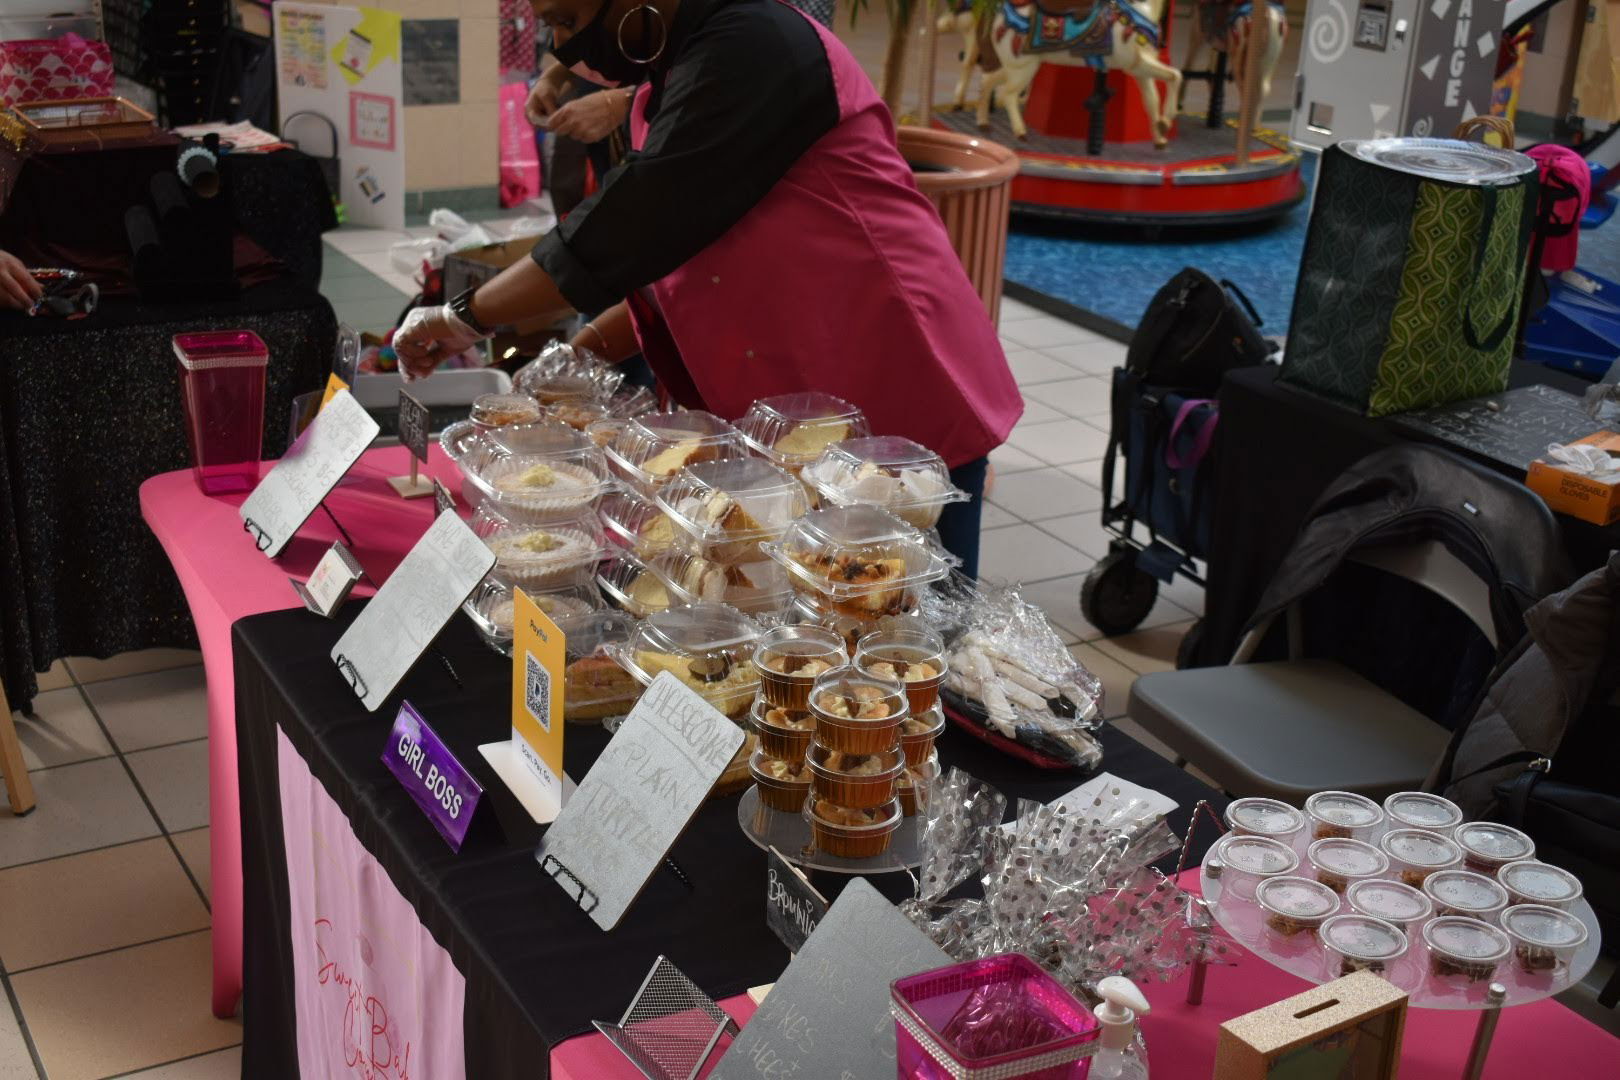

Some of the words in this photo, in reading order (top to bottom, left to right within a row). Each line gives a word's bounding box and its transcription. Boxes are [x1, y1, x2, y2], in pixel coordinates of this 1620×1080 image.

[1561, 478, 1608, 498] DISPOSABLE
[529, 618, 548, 642] PayPal
[642, 676, 728, 771] CHEESECAKE
[398, 733, 425, 779] GIRL
[424, 764, 463, 819] BOSS
